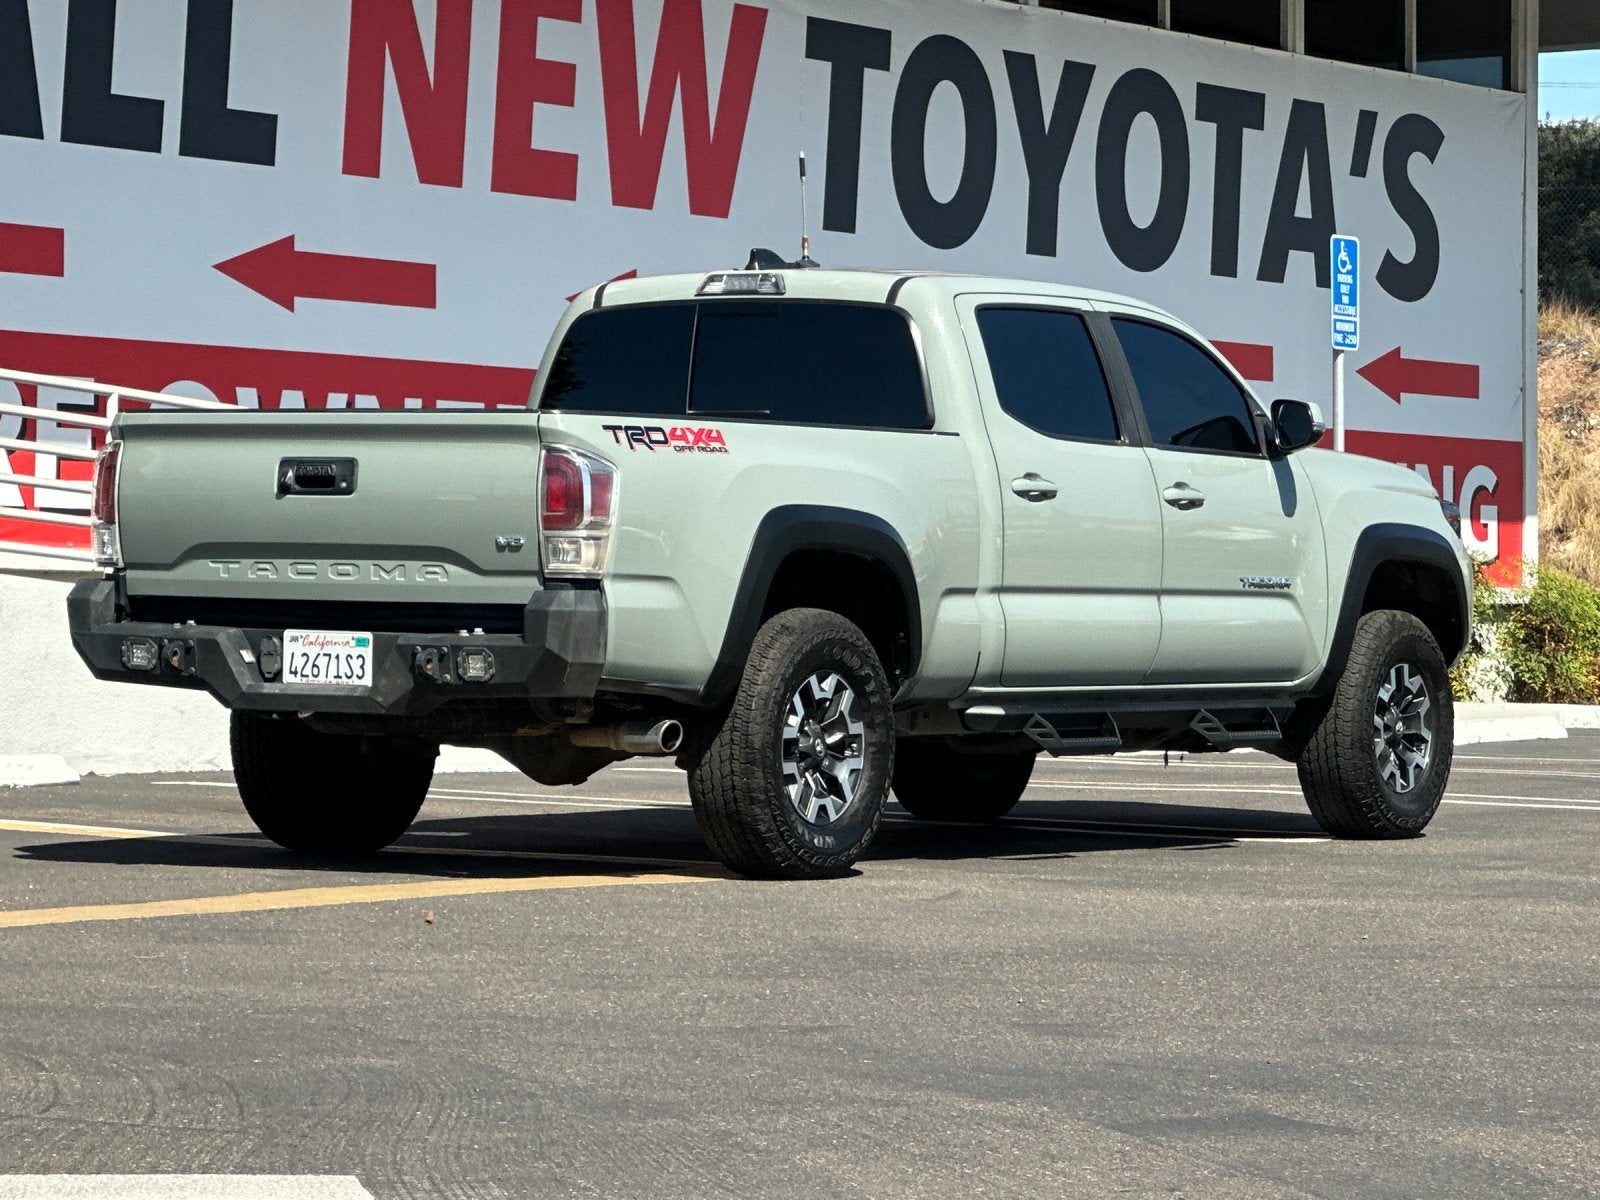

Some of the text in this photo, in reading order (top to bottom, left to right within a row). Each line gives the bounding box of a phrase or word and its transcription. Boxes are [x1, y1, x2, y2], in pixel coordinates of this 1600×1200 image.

[0, 0, 1445, 302] LL NEW TOYOTA'S
[602, 425, 726, 451] TRD 4X4
[208, 560, 448, 582] TACOMA
[302, 634, 351, 651] California
[289, 651, 366, 680] 42671S3
